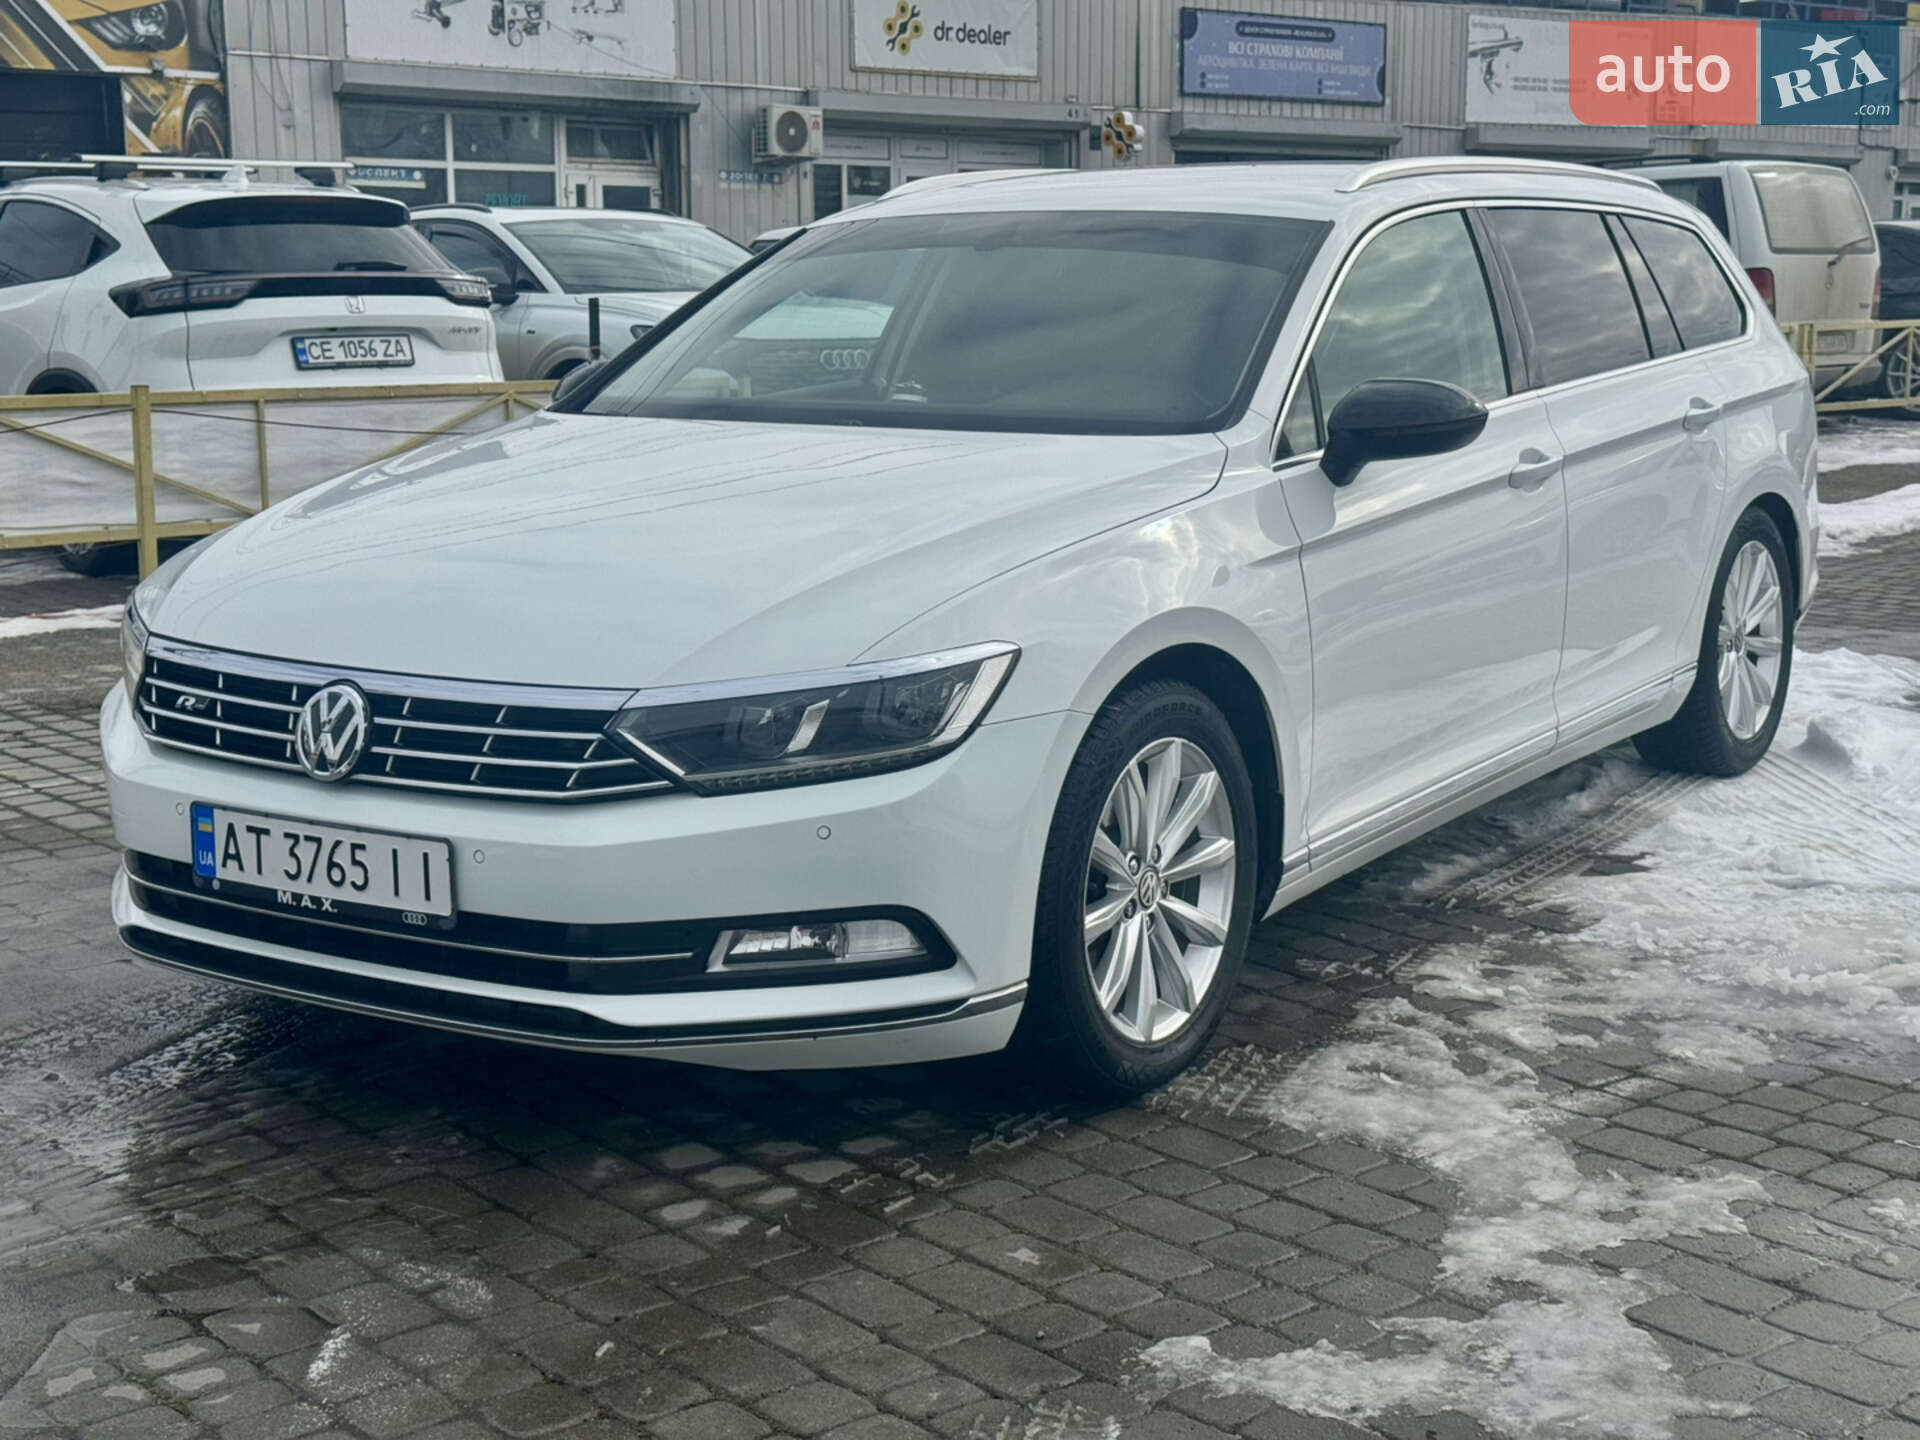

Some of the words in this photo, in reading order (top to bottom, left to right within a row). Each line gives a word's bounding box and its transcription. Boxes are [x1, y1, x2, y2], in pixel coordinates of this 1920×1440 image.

[307, 340, 335, 361] CE
[338, 340, 378, 360] 1056
[379, 339, 407, 358] ZA
[199, 851, 214, 867] UA
[221, 822, 271, 876] AT
[283, 831, 369, 892] 3765
